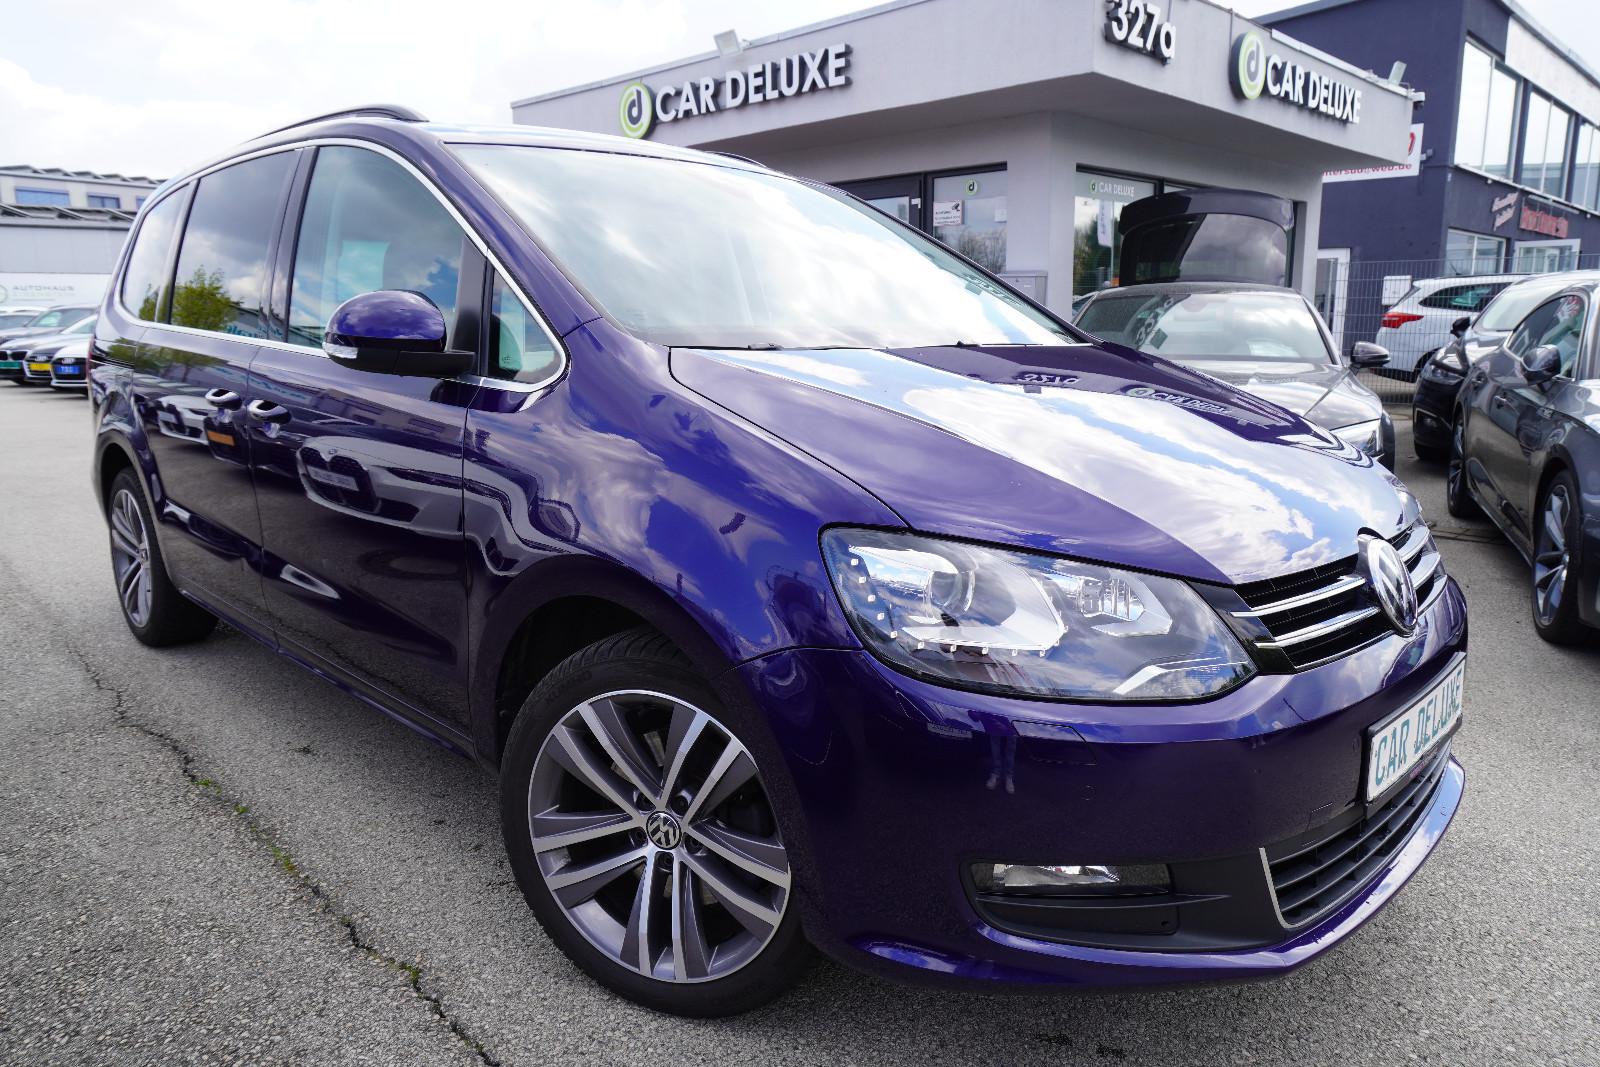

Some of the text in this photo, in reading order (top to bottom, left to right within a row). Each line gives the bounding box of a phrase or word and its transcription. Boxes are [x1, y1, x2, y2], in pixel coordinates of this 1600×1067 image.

[655, 76, 716, 122] CAR
[725, 43, 847, 109] DELUXE
[1266, 54, 1304, 105] CAR
[1308, 71, 1362, 124] DELUXE
[1098, 182, 1135, 198] CAR DELUXE
[1374, 718, 1410, 787] CAR
[1414, 667, 1462, 755] DELUXE
